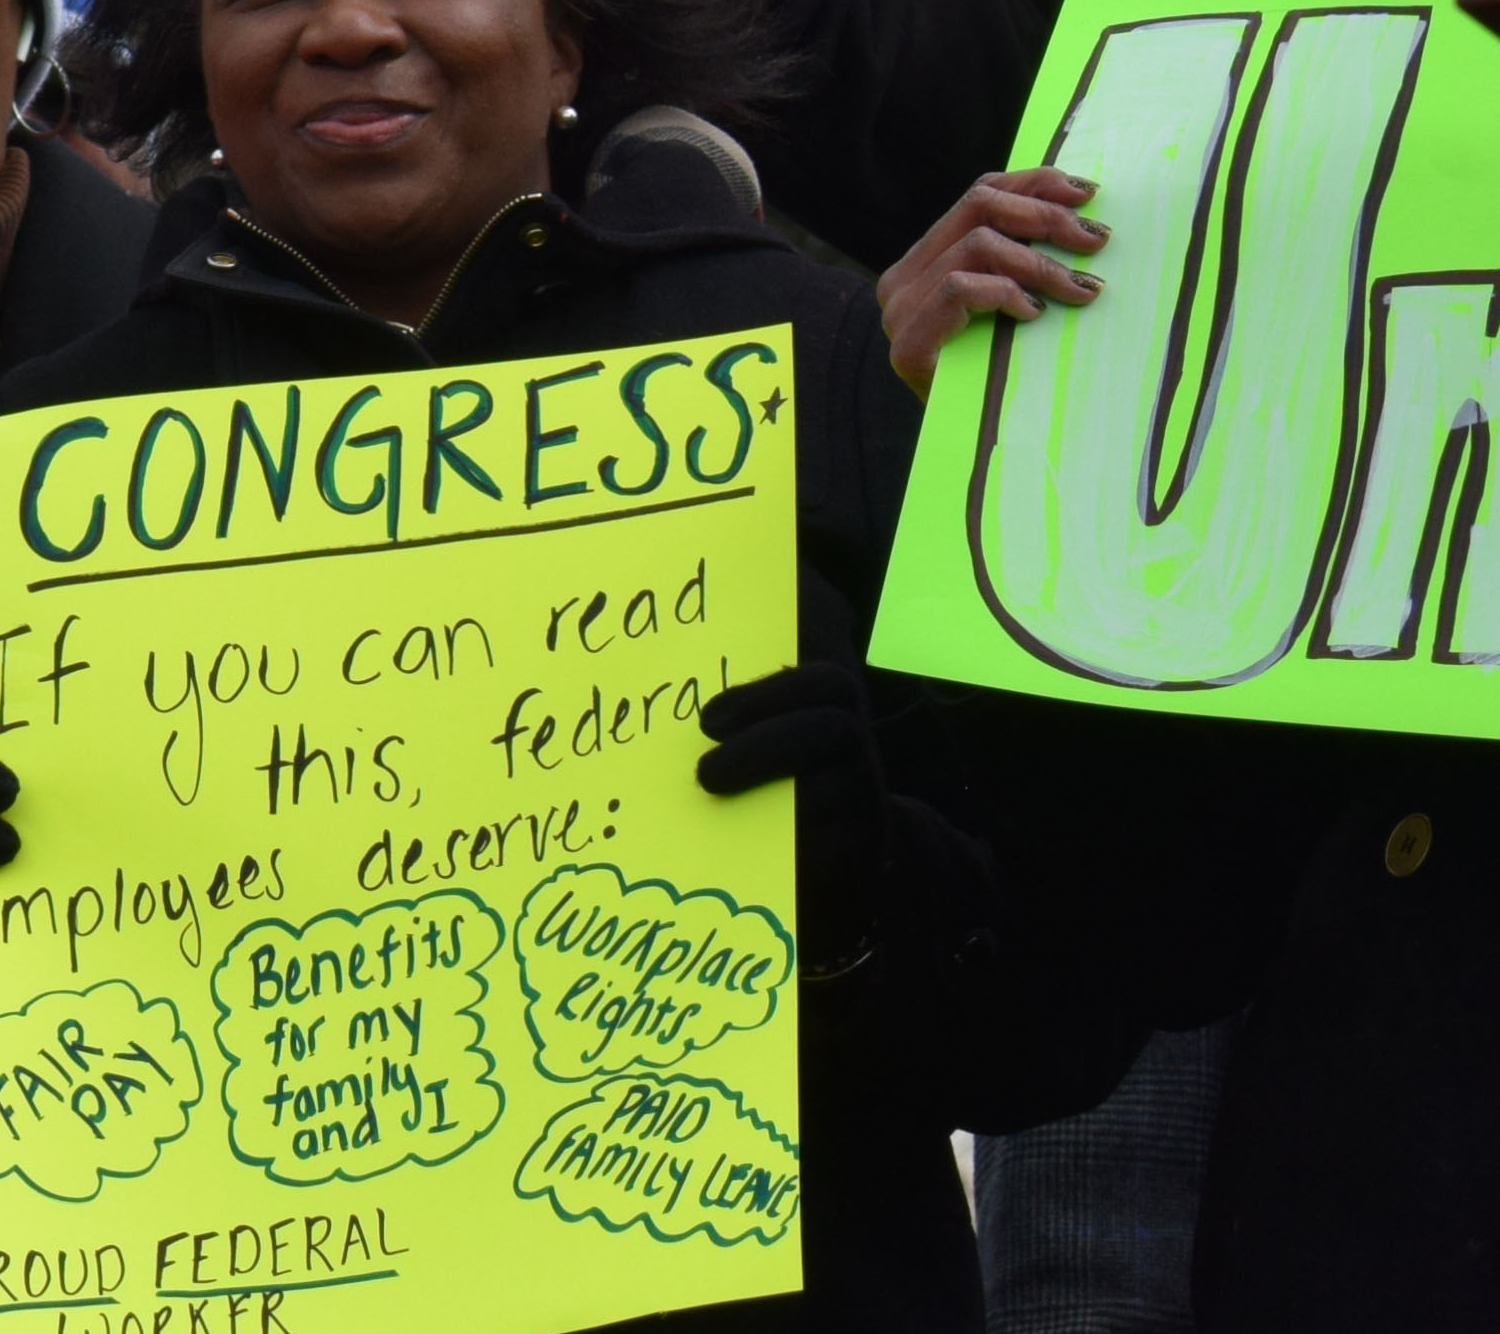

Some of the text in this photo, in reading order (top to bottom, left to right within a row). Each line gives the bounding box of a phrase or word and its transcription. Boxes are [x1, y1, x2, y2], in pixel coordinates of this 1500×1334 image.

[17, 341, 778, 563] CONGRESS
[143, 642, 298, 807] you
[342, 617, 494, 686] can
[544, 556, 706, 655] read
[254, 722, 421, 814] this,
[357, 797, 621, 892] deserve:
[249, 915, 465, 1010] Benefits
[534, 890, 773, 995] Workplace
[264, 998, 422, 1067] for my
[71, 1041, 175, 1140] PAY
[263, 1056, 423, 1132] family
[292, 1078, 460, 1160] and I
[602, 1083, 711, 1143] PAID
[543, 1123, 694, 1214] FAMILY
[154, 1207, 410, 1289] FEDERAL
